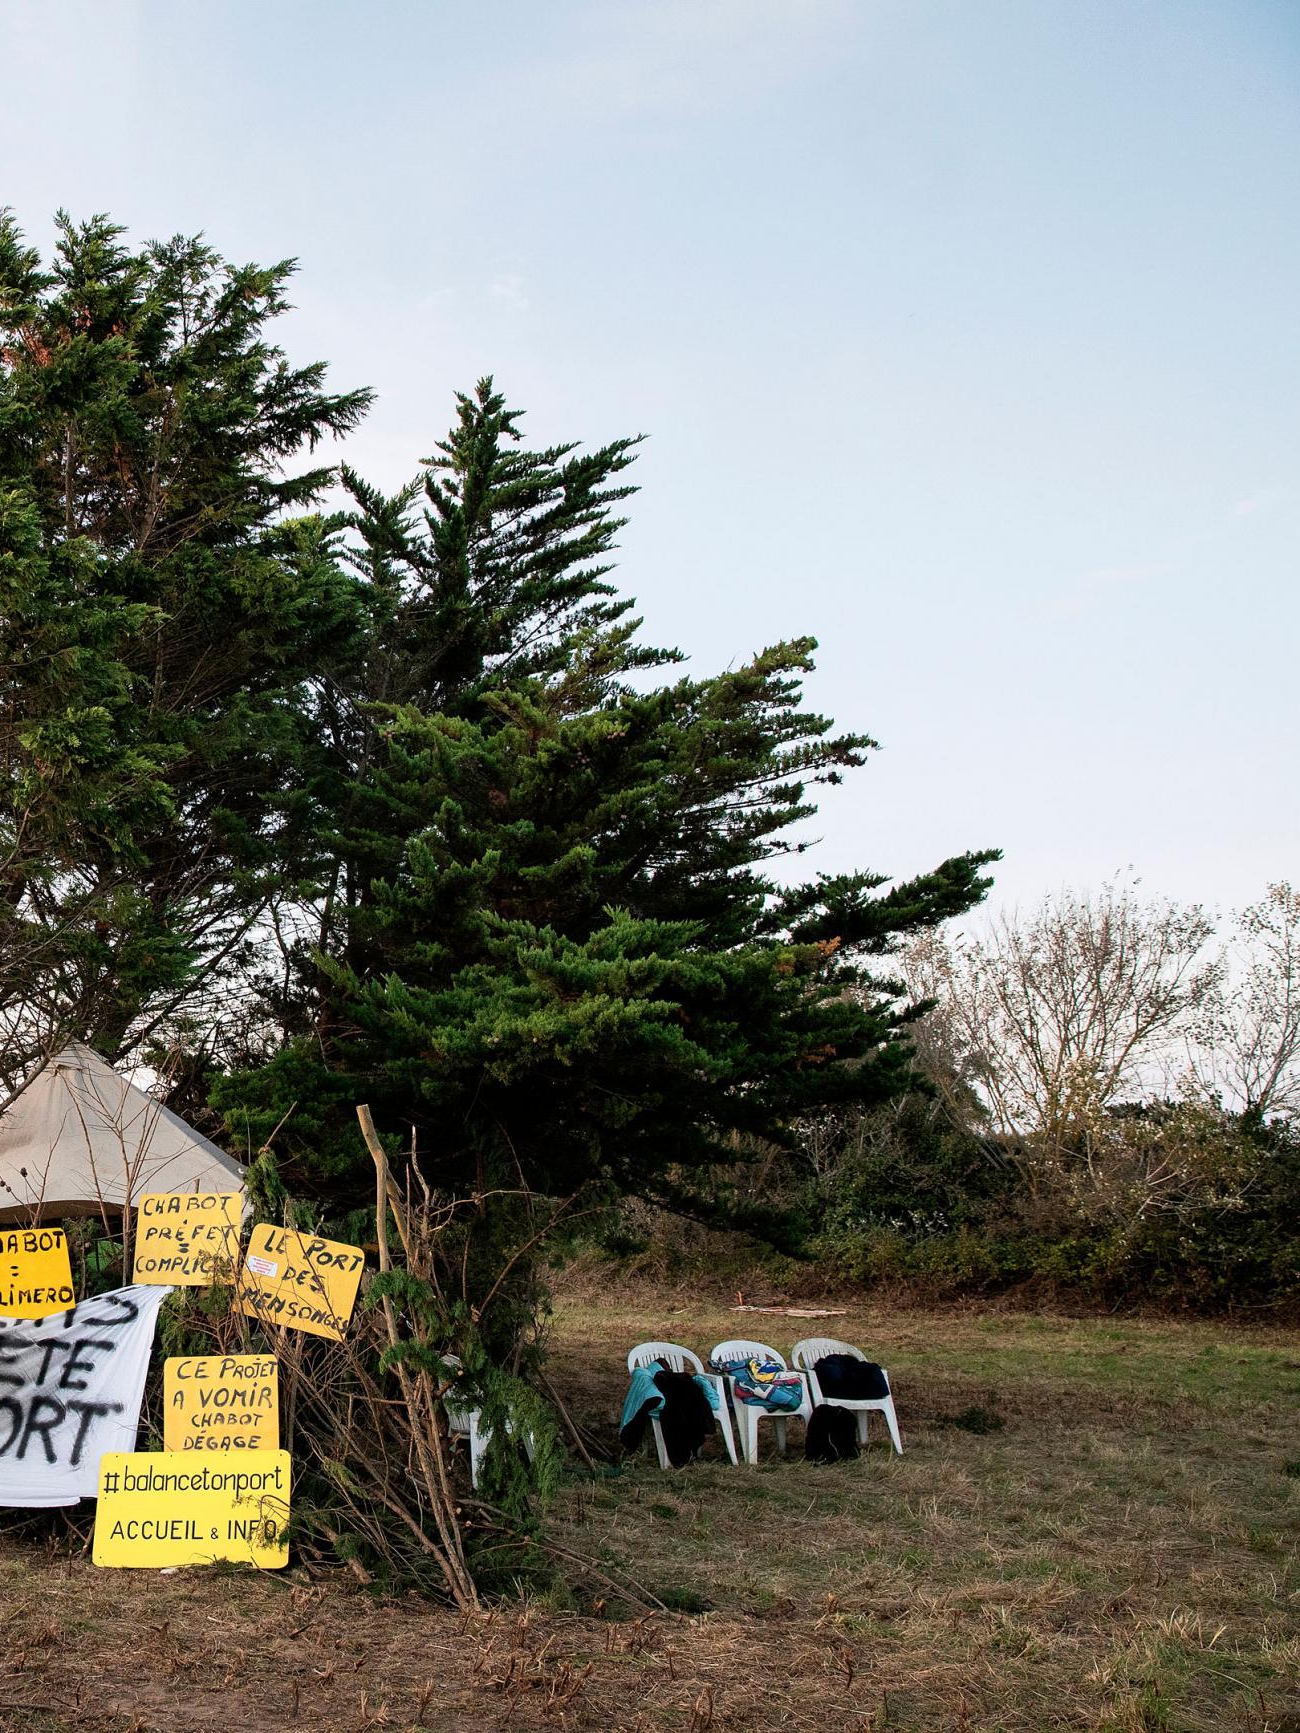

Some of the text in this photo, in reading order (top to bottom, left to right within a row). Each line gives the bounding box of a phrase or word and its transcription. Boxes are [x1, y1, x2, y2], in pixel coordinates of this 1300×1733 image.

[144, 1195, 234, 1217] CHABOT
[263, 1229, 292, 1255] LE
[303, 1238, 364, 1273] PORT
[135, 1252, 234, 1277] COMPLIC
[281, 1266, 326, 1293] DES
[176, 1359, 210, 1380] CE
[173, 1390, 185, 1410] A
[191, 1412, 263, 1428] CHABOT
[183, 1430, 262, 1451] DÉGAGE
[103, 1464, 283, 1500] #balancetonport
[109, 1519, 278, 1540] ACCUEIL & INFO
